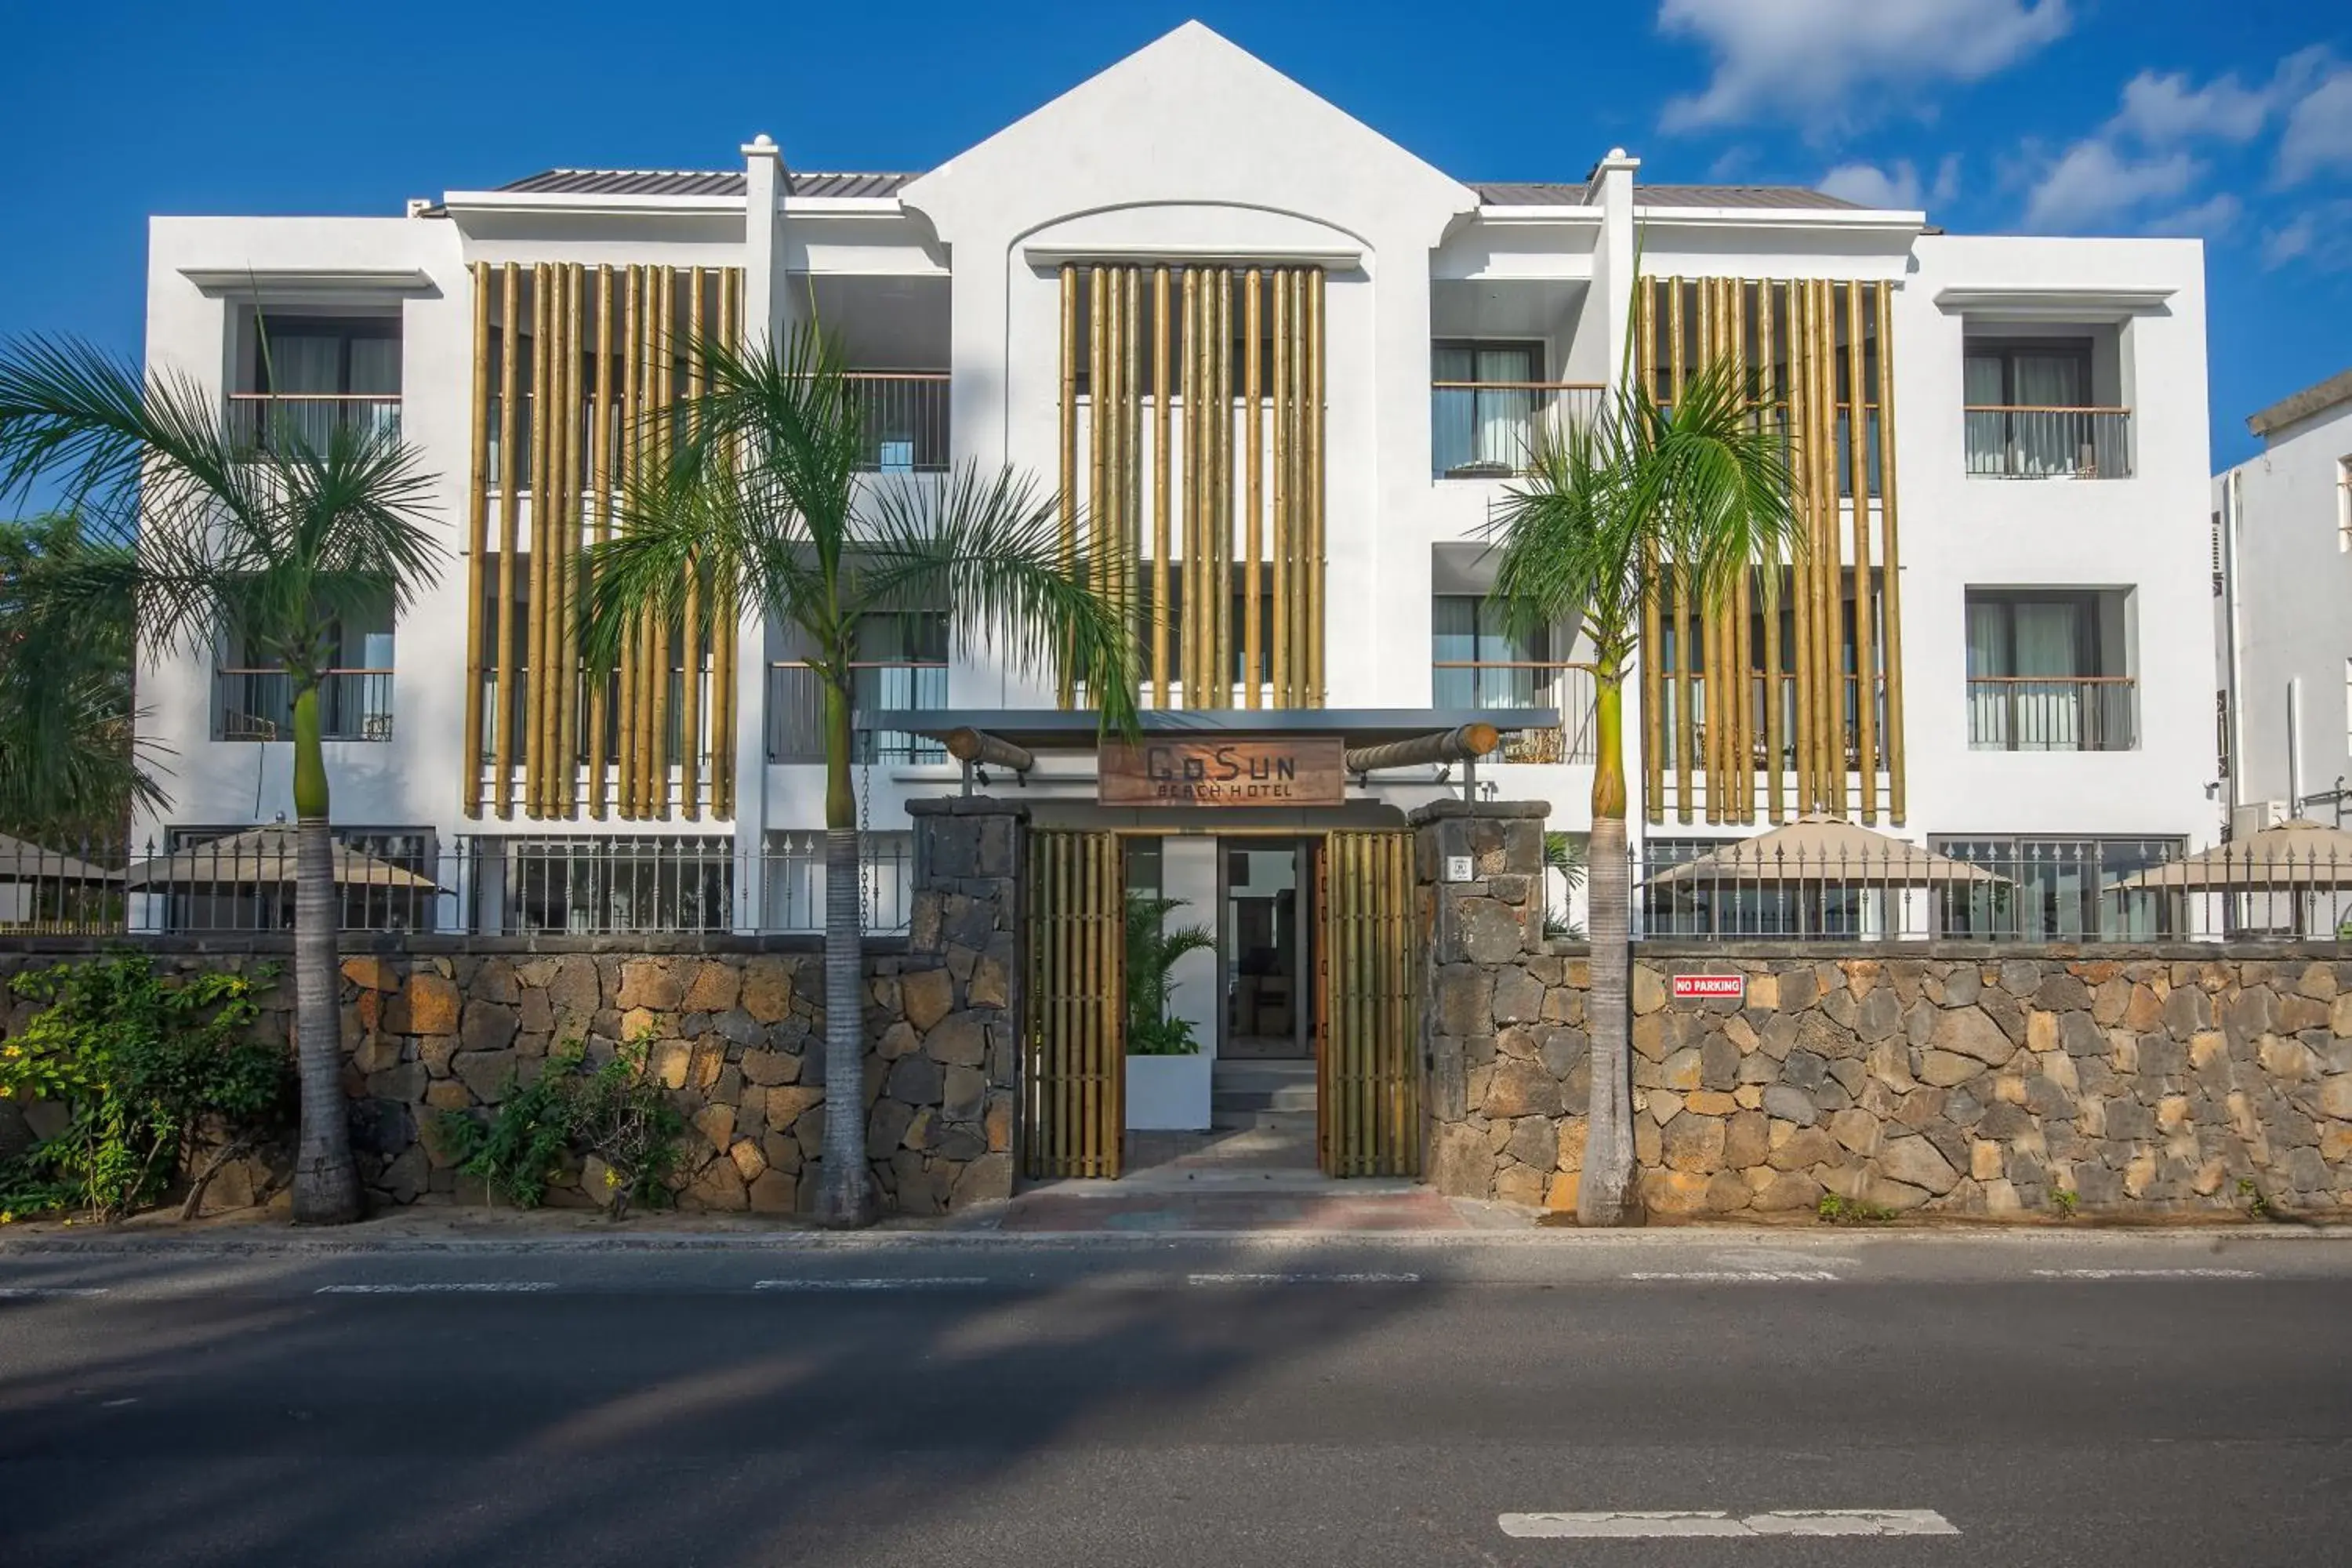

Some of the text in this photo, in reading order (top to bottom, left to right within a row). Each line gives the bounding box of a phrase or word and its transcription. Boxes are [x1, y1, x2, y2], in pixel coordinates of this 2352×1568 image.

[1158, 785, 1291, 797] BEACH HOTEL
[1677, 980, 1739, 991] NO PARKING
